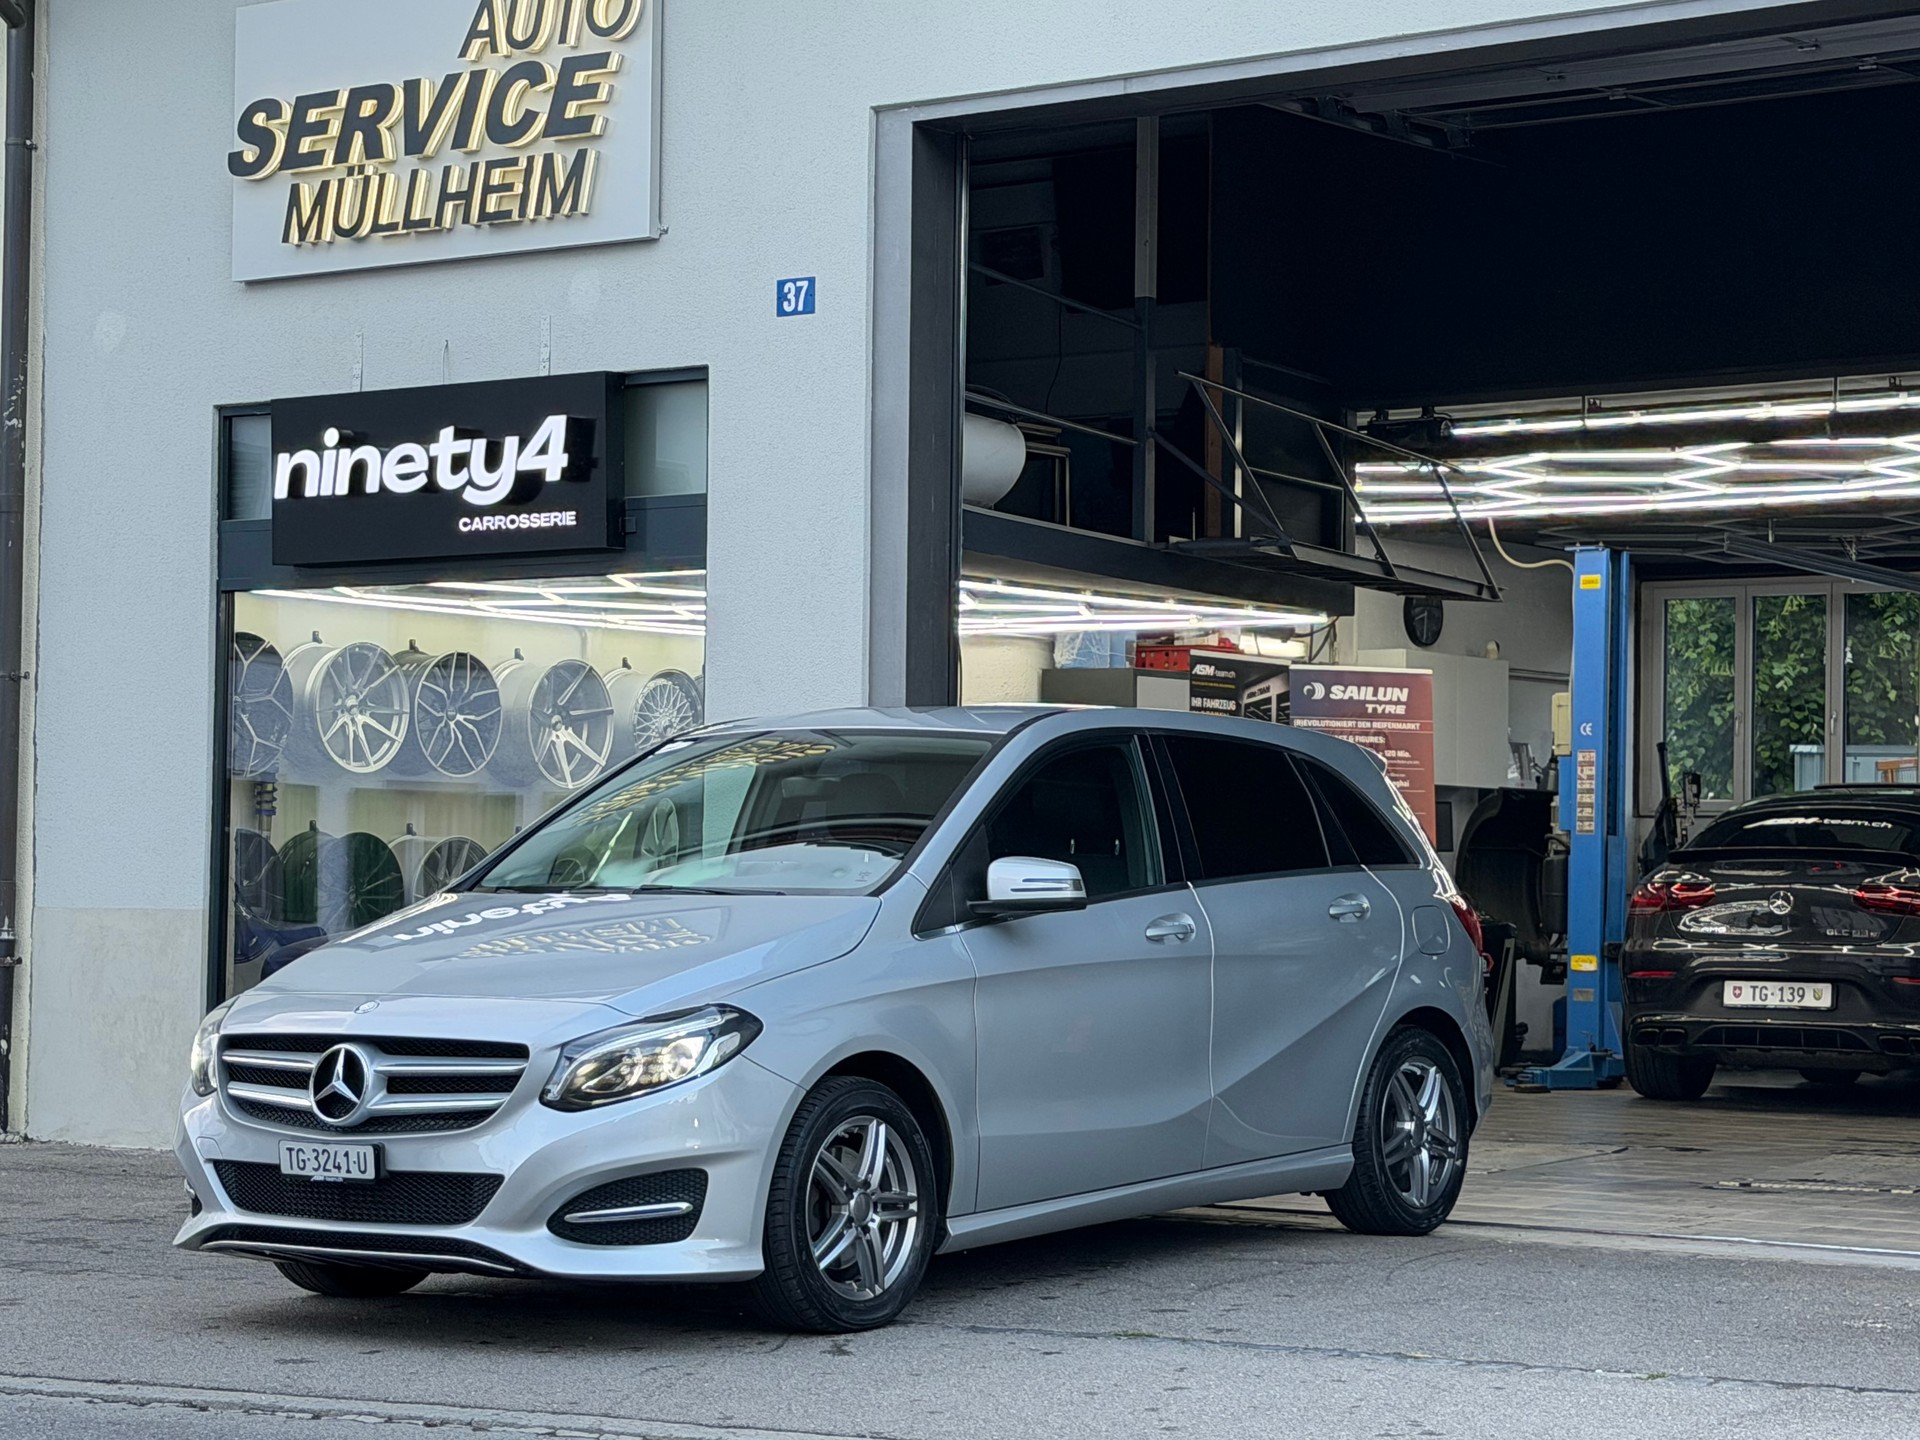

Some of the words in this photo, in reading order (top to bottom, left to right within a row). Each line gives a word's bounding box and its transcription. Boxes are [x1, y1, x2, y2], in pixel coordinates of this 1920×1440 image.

[227, 50, 624, 181] SERVICE
[281, 147, 600, 245] MÜLLHEIM
[783, 280, 809, 312] 37
[274, 414, 569, 506] ninety4
[458, 511, 577, 532] CARROSSERIE
[1191, 697, 1203, 707] IHR
[1203, 698, 1237, 711] FAHRZEUG
[1329, 685, 1409, 702] SAILUN
[1365, 703, 1407, 715] TYRE
[1372, 721, 1421, 730] REIFENMARKT
